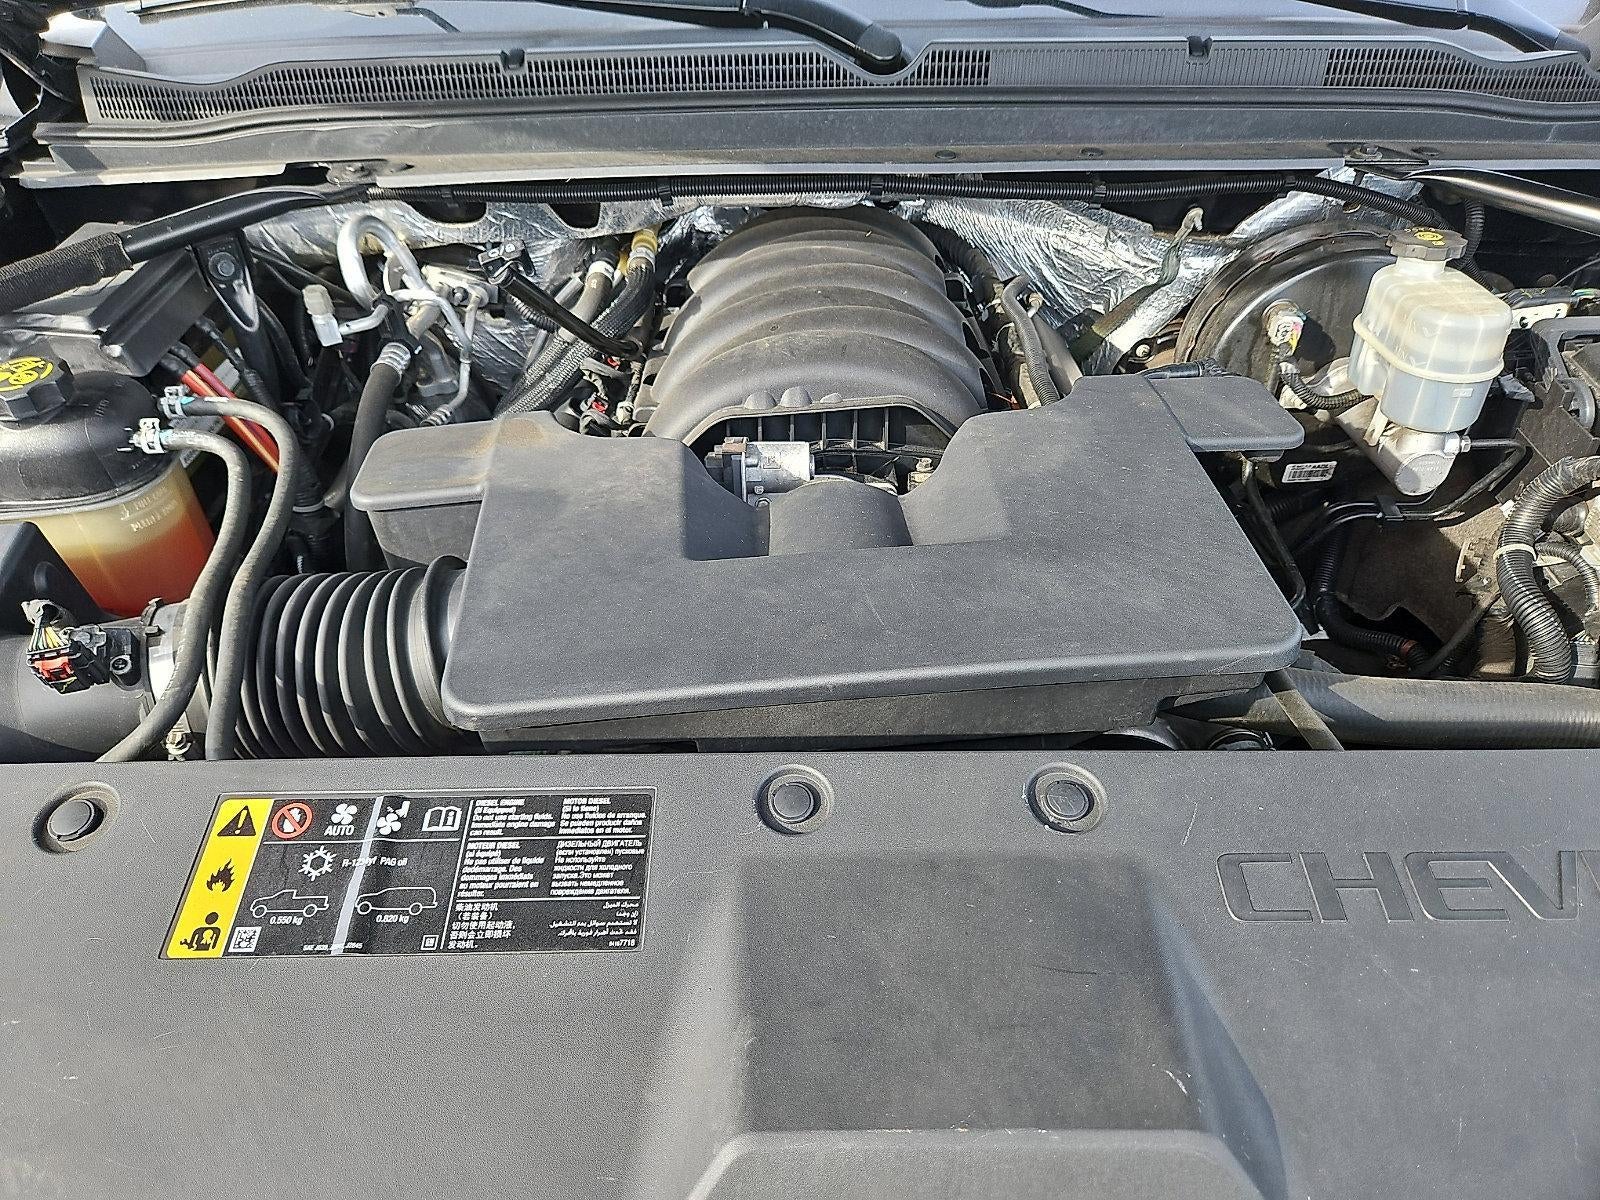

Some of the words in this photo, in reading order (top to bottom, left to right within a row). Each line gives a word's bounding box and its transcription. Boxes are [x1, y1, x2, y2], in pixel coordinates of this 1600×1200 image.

[324, 825, 355, 836] AUTO
[556, 839, 601, 849] ДИЗЕЛЬНЫЙ
[601, 840, 642, 848] ДВИГАТЕЛЬ
[380, 857, 397, 866] PAG
[1216, 850, 1600, 923] CHEV
[455, 903, 498, 911] 柴油发动机
[292, 916, 303, 925] kg
[399, 914, 410, 924] kg
[450, 930, 511, 940] 否则会立即损坏
